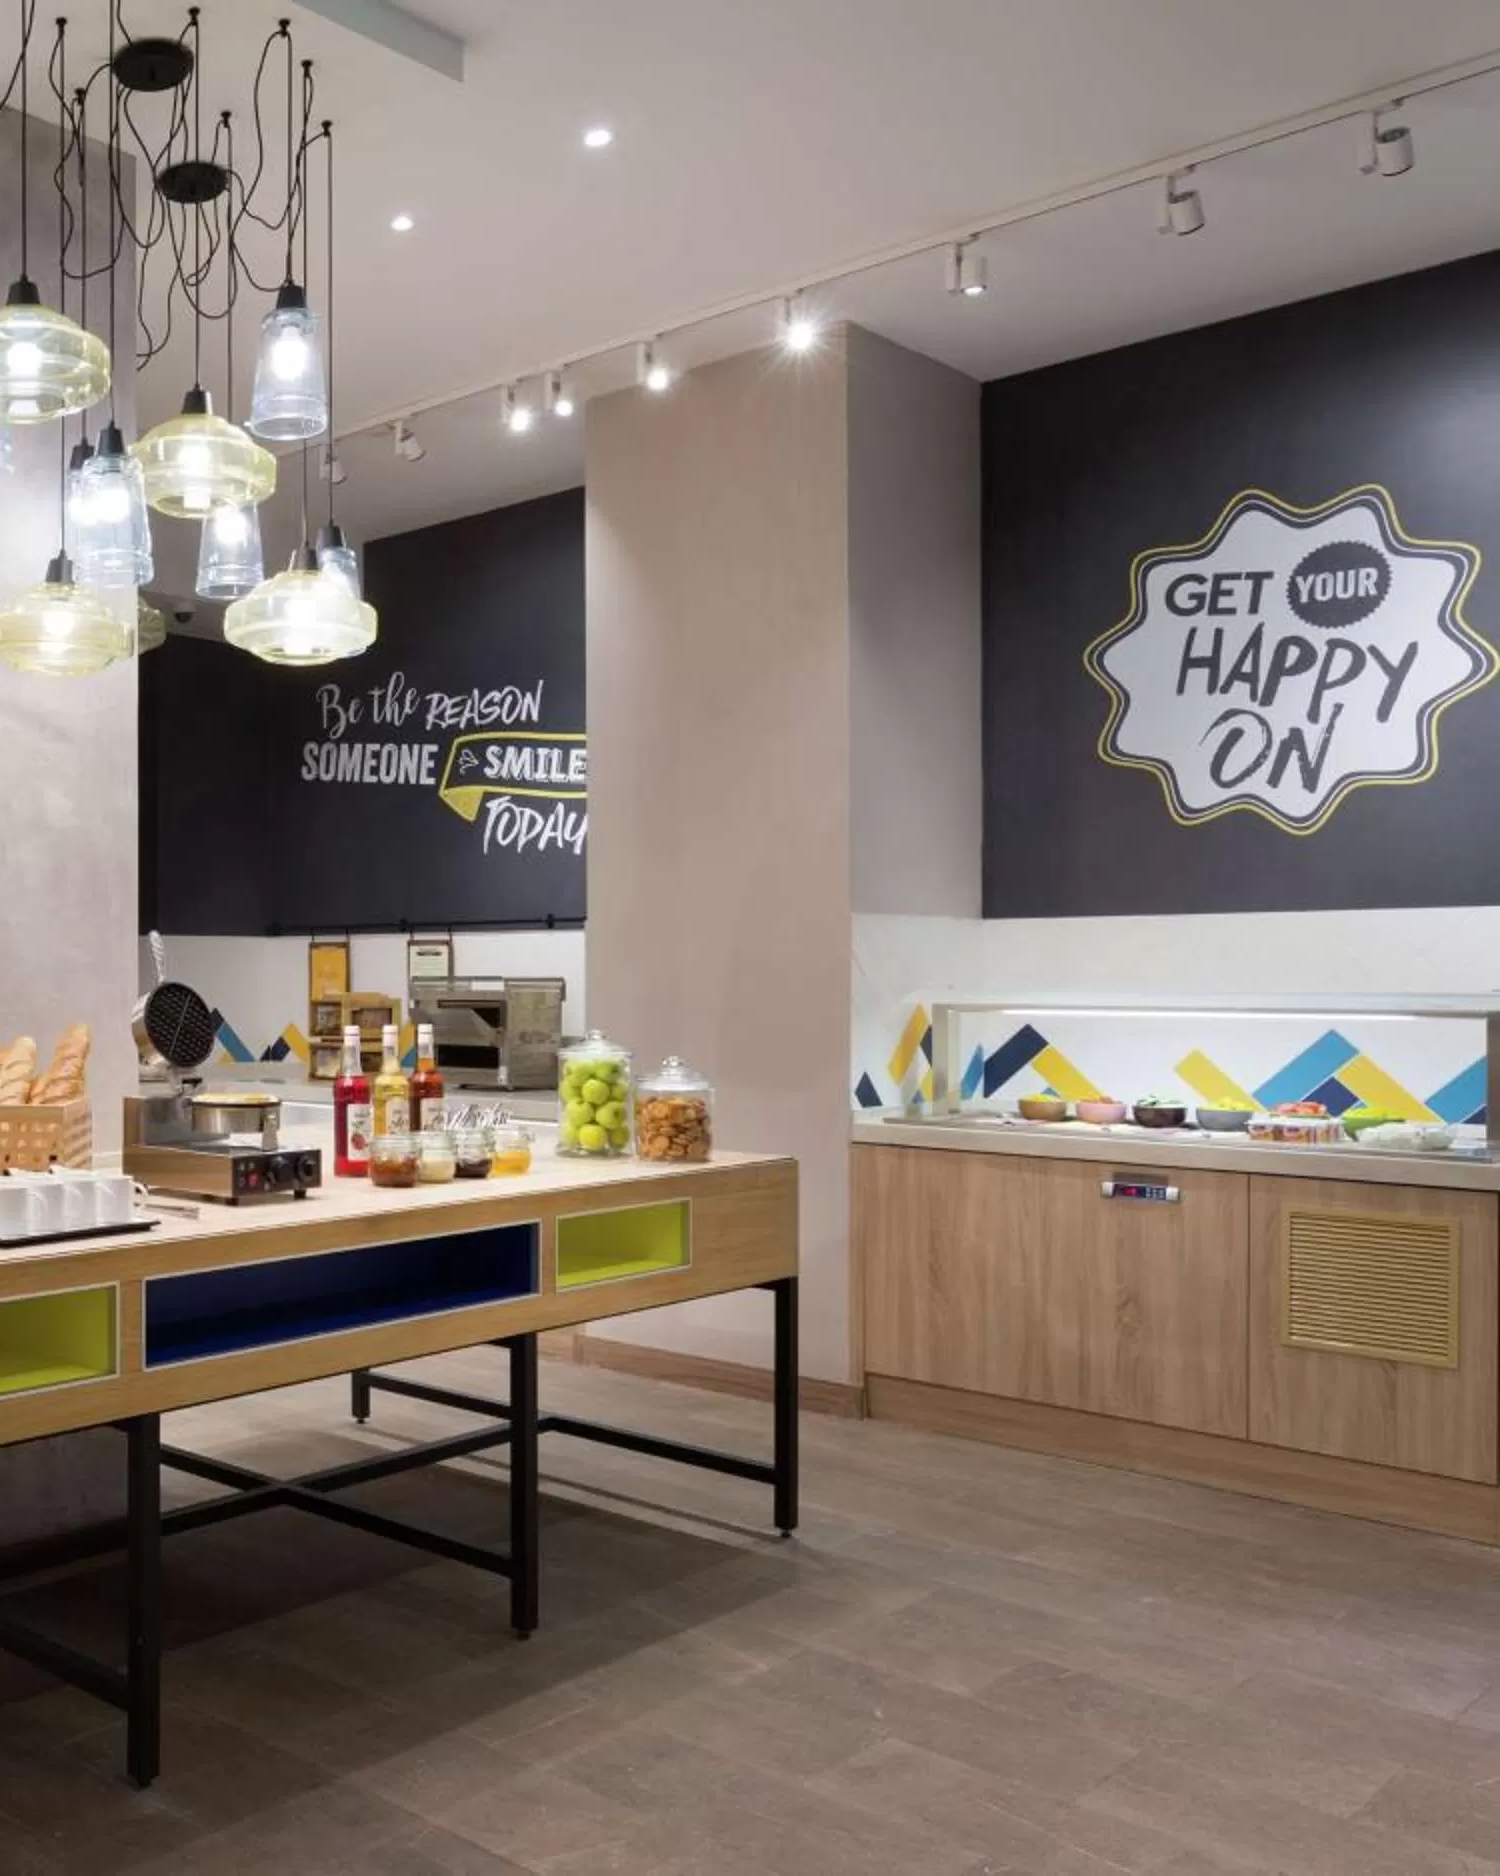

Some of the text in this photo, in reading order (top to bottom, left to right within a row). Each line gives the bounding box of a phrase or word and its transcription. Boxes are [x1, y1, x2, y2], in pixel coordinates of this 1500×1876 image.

[1165, 567, 1378, 616] GET YOUR
[316, 671, 543, 738] Be the REASON
[1176, 622, 1418, 724] HAPPY
[301, 741, 438, 785] SOMEONE
[1199, 702, 1344, 794] ON
[483, 795, 589, 855] TODAY
